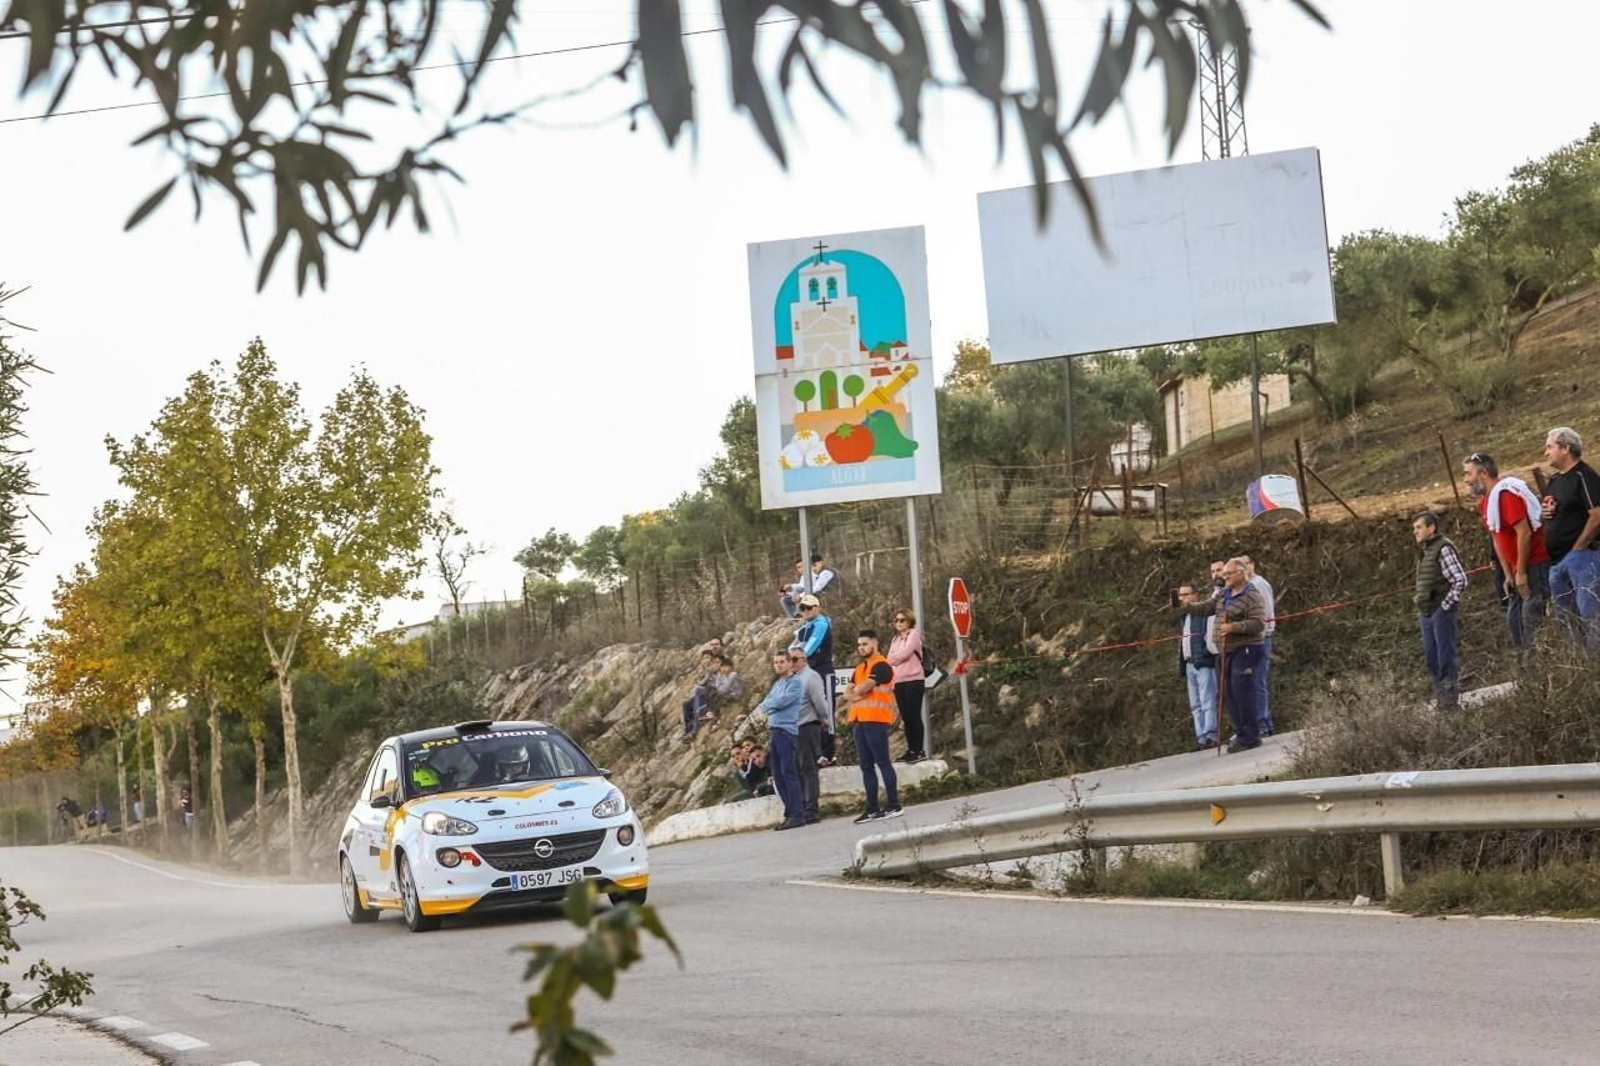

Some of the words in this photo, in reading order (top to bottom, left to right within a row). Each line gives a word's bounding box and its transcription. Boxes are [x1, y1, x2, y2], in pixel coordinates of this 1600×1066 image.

[953, 601, 968, 614] STOP
[421, 738, 459, 749] Pro
[520, 872, 552, 887] 0597
[558, 869, 582, 883] JSG
